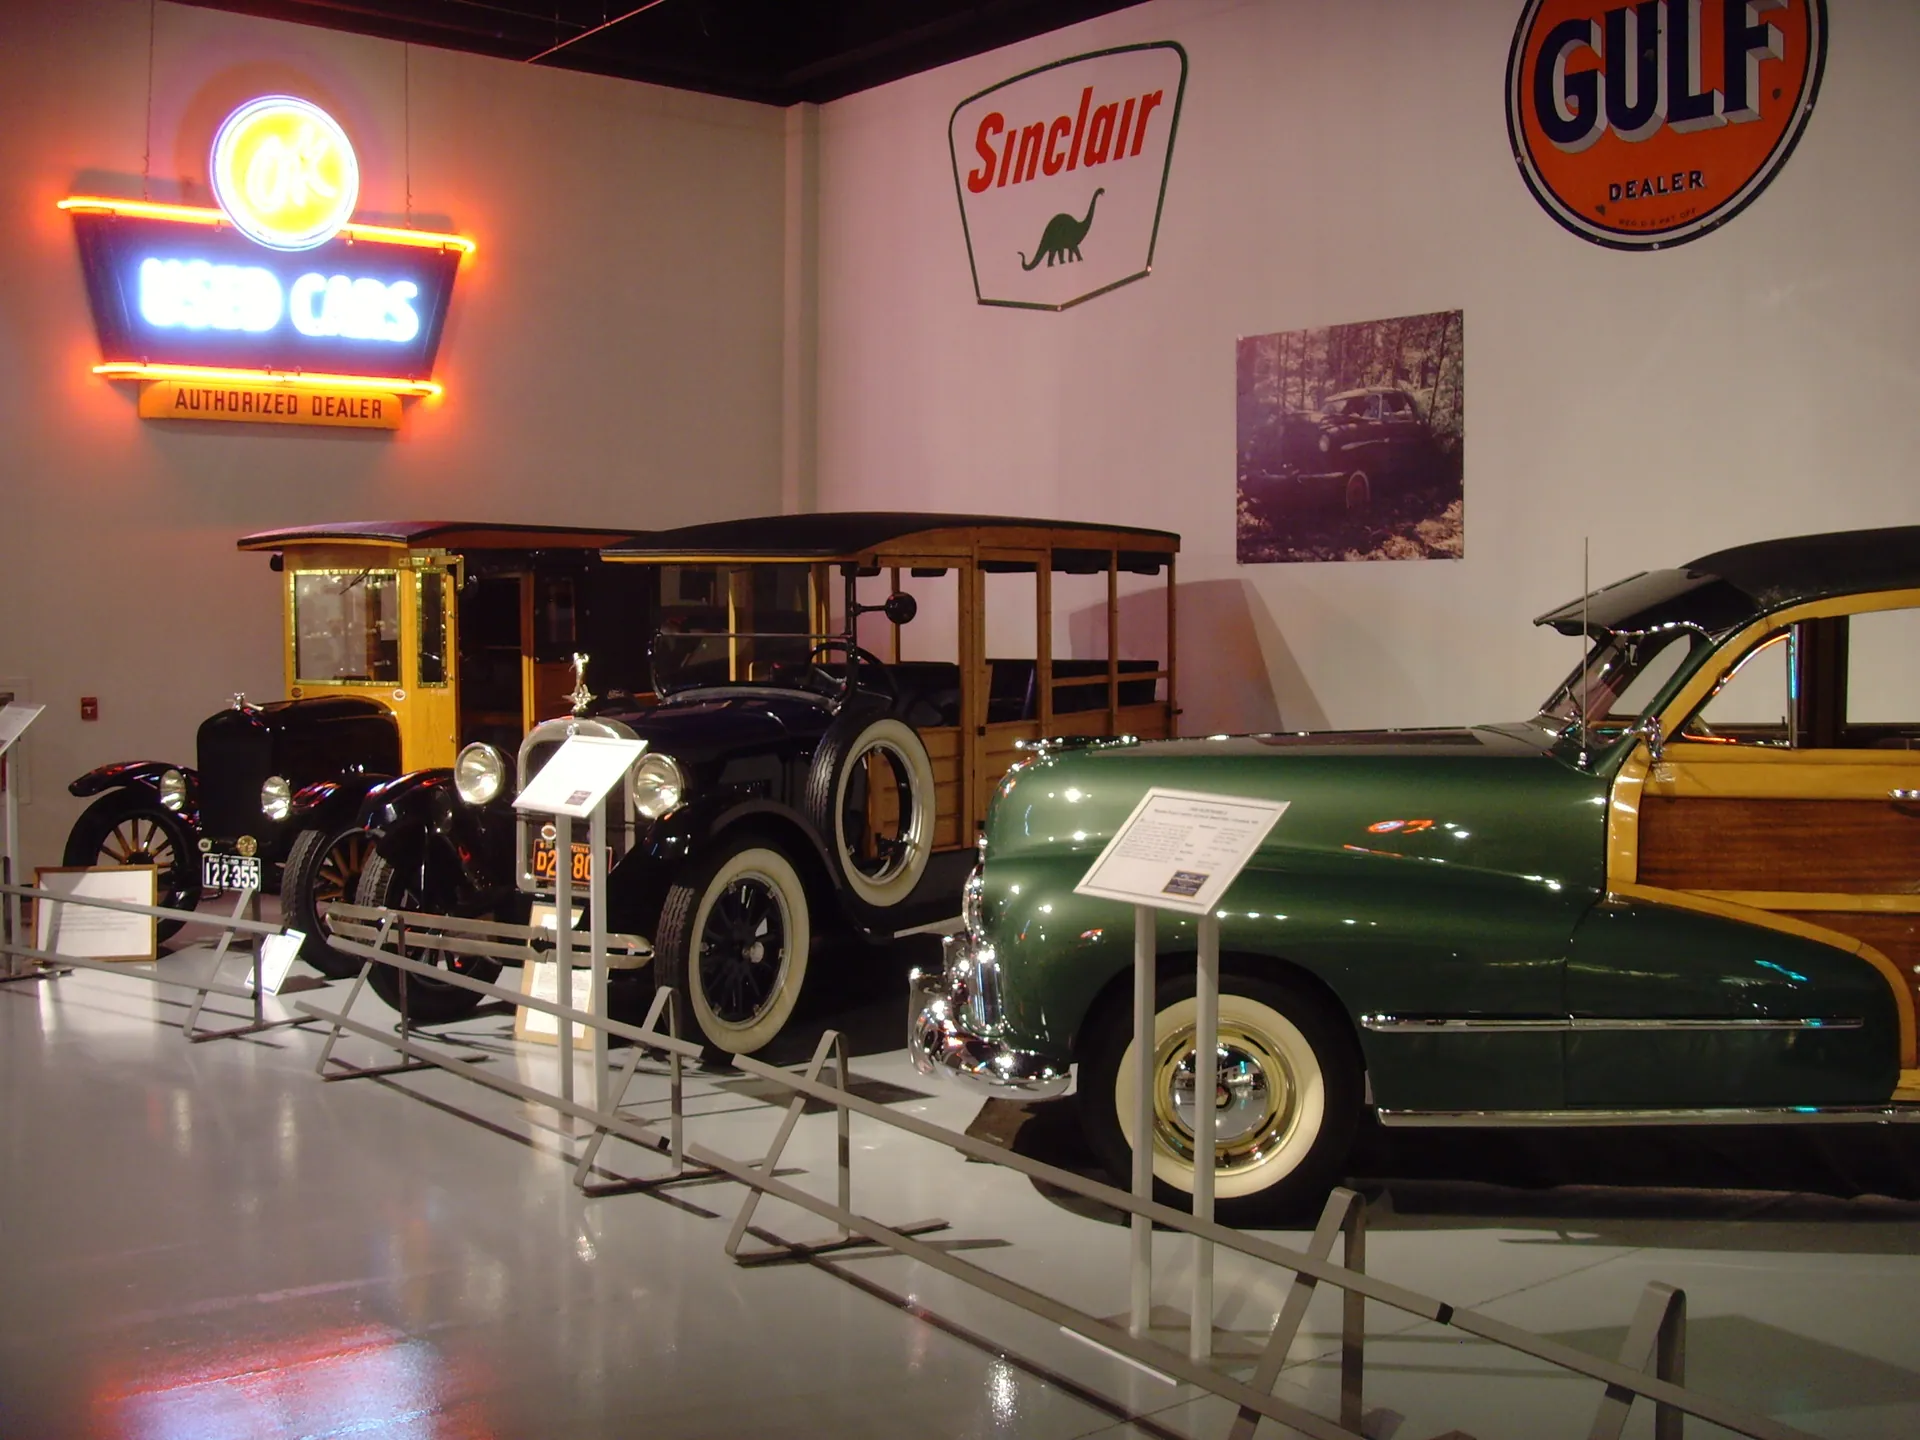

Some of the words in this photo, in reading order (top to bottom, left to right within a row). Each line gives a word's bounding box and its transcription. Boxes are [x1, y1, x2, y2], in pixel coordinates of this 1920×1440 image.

[1534, 0, 1788, 153] GULF
[246, 122, 337, 213] OK
[967, 86, 1163, 193] Sinclair
[1609, 170, 1705, 202] DEALER
[140, 258, 282, 332] USED
[290, 273, 420, 342] CARS
[175, 388, 299, 415] AUTHORIZED
[312, 394, 383, 420] DEALER
